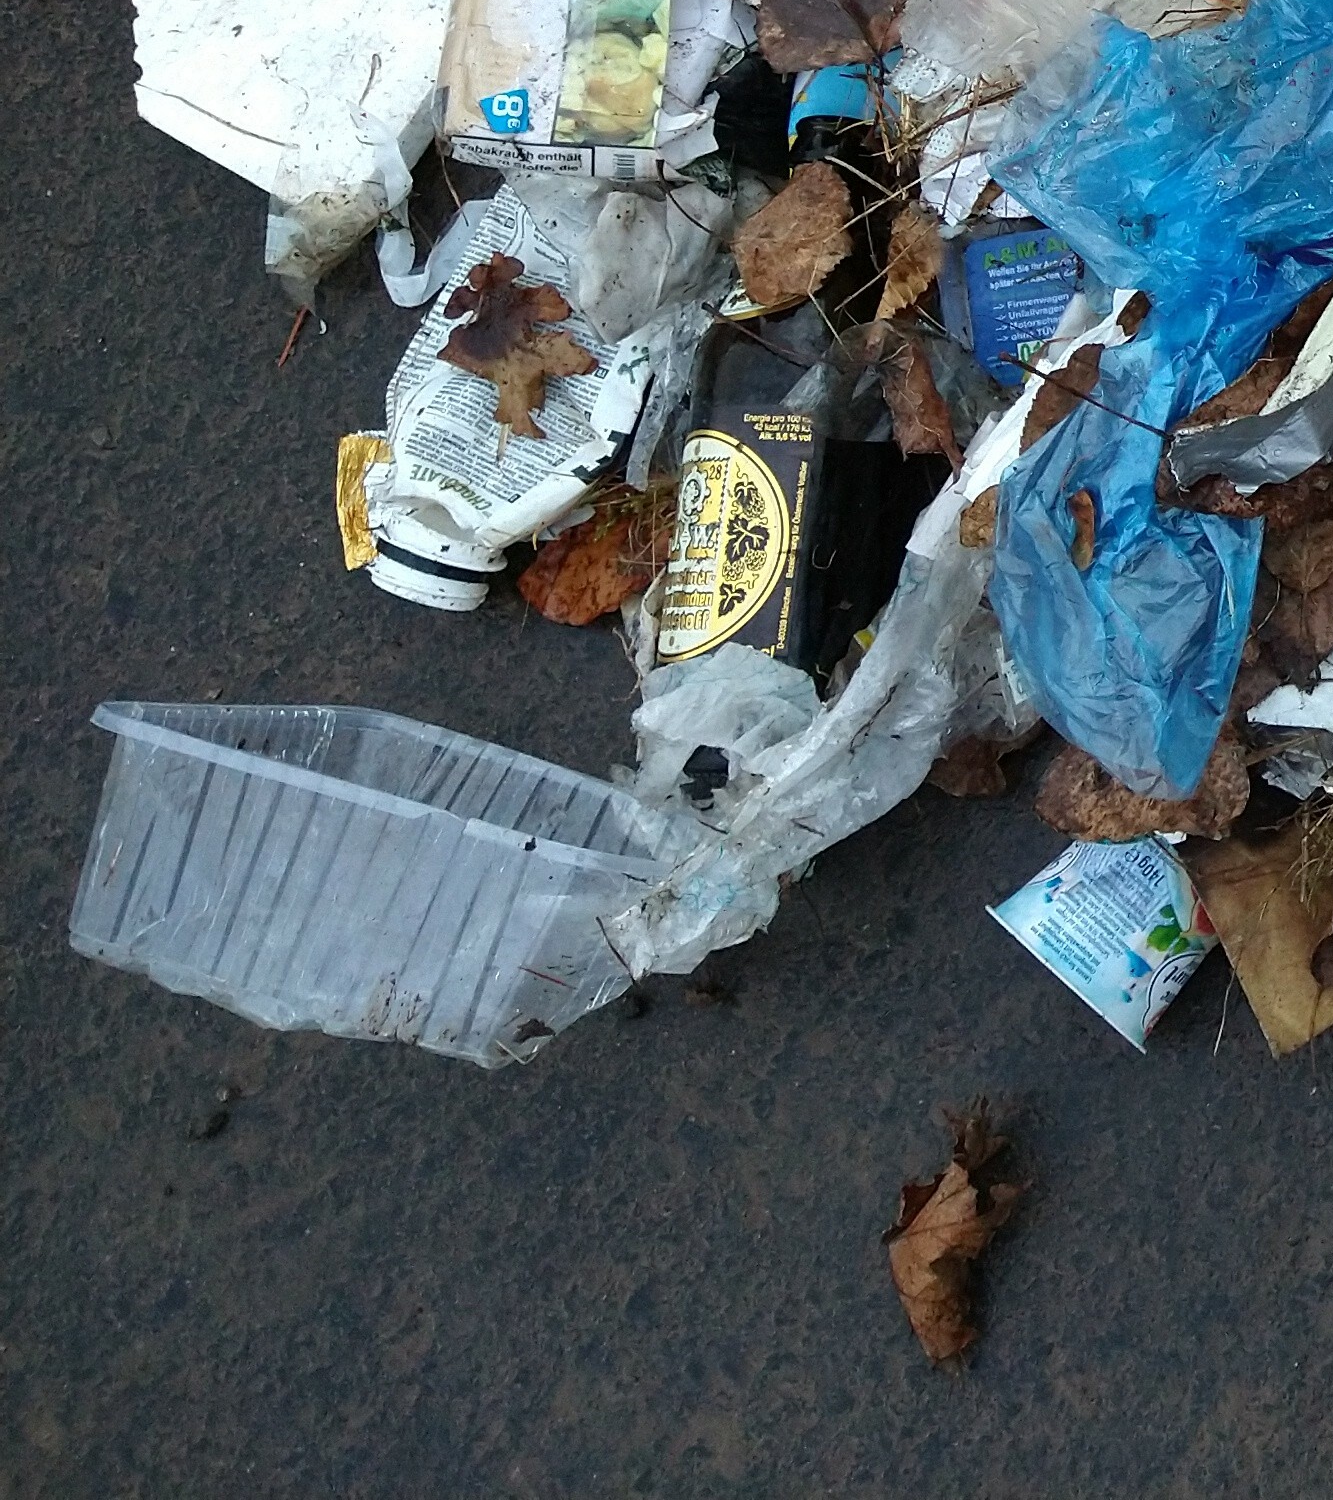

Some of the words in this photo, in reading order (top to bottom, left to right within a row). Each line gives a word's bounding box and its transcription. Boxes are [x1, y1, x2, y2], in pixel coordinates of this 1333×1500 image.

[1007, 293, 1070, 309] Firmenwagen
[1008, 305, 1065, 319] Unfallwagen
[744, 413, 770, 424] Energie
[709, 464, 723, 481] 28
